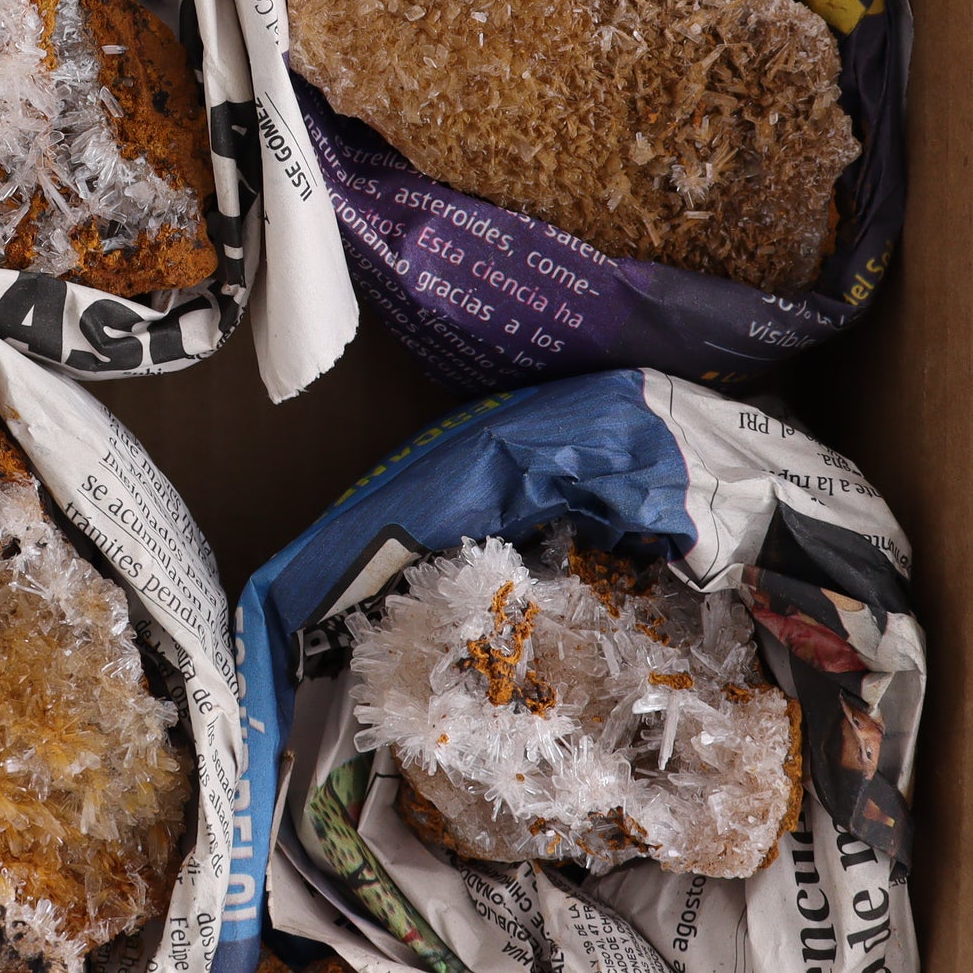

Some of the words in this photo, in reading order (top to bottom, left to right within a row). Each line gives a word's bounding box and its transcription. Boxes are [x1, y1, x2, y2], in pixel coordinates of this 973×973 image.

[255, 97, 292, 163] GÓMEZ
[285, 161, 313, 202] ILSE
[303, 114, 381, 200] naturales,
[394, 187, 515, 257] asteroides,
[527, 251, 601, 297] come-
[415, 270, 495, 322] gracias
[505, 318, 521, 335] a
[531, 326, 566, 354] los
[417, 226, 466, 266] Esta
[472, 261, 548, 313] ciencia
[554, 302, 584, 329] ha
[739, 412, 770, 434] PRI
[817, 476, 834, 496] la
[65, 501, 144, 580] trámites
[81, 474, 109, 503] se
[108, 497, 204, 614] acumularon
[170, 915, 190, 973] Felipe
[673, 875, 707, 952] agosto
